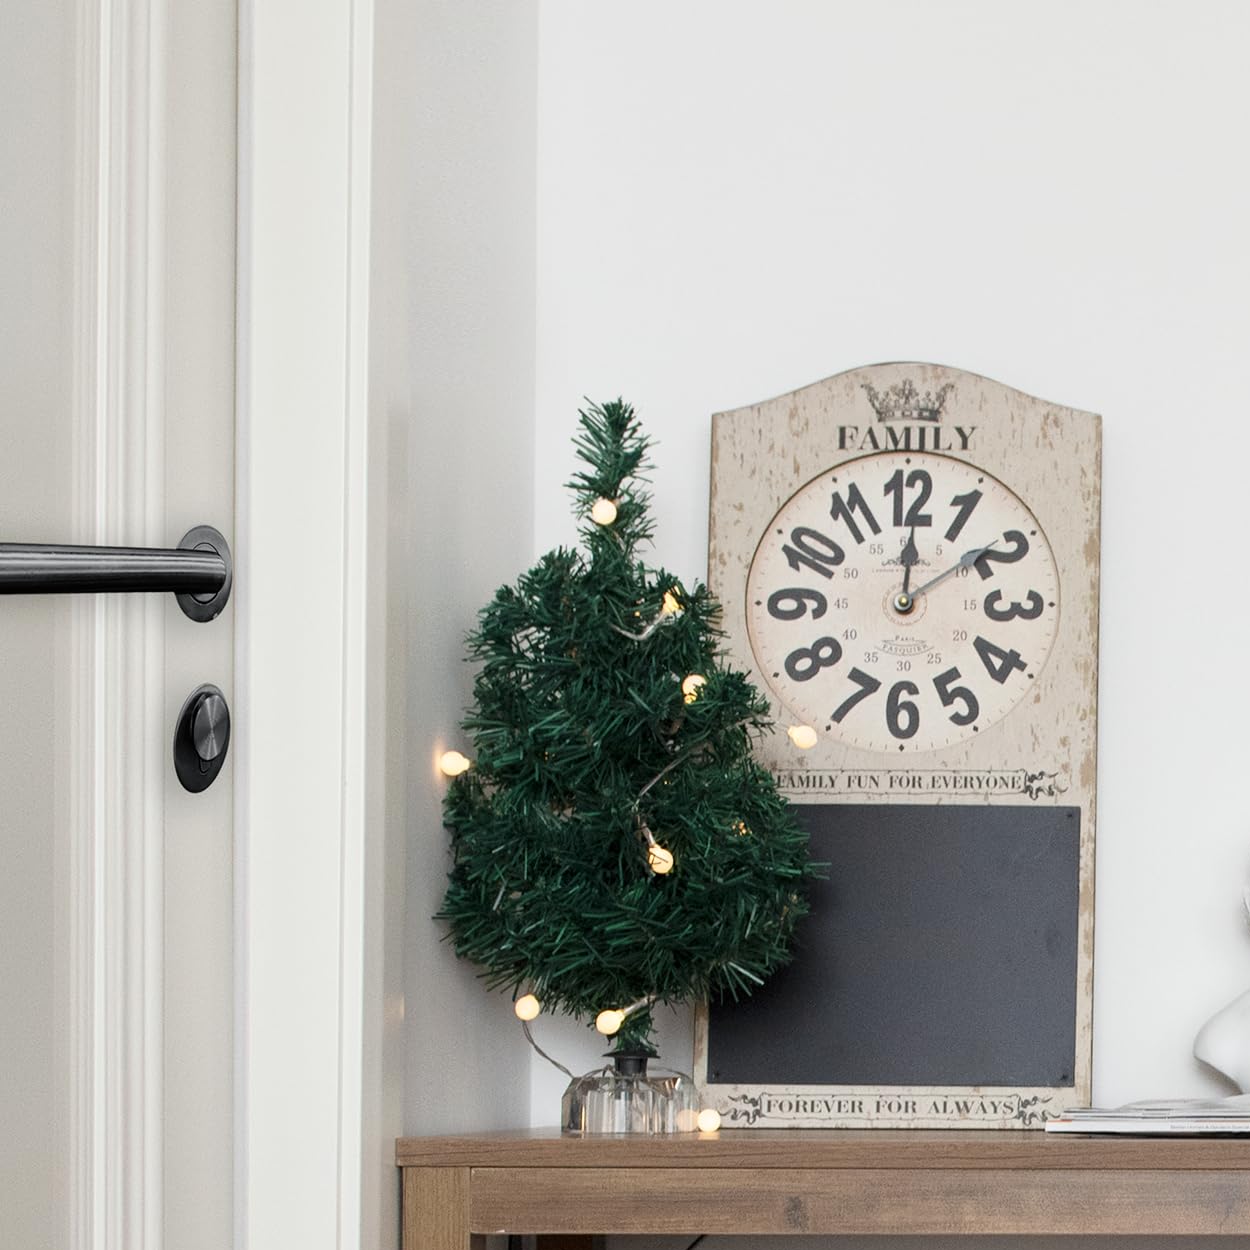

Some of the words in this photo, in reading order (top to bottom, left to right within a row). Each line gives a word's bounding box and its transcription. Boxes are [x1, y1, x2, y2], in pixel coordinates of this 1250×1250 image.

[837, 426, 977, 450] FAMILY
[884, 469, 933, 527] 12
[830, 482, 882, 545] 11
[944, 488, 983, 543] 1
[781, 526, 846, 580] 10
[869, 543, 884, 555] 55
[935, 544, 943, 556] 5
[973, 530, 1030, 581] 2
[843, 568, 858, 579] 50
[954, 567, 969, 578] 10
[767, 587, 828, 621] 9
[833, 598, 849, 610] 45
[963, 600, 977, 611] 15
[983, 589, 1044, 622] 3
[842, 629, 857, 641] 40
[952, 630, 968, 642] 20
[784, 636, 843, 682] 8
[864, 652, 878, 663] 35
[896, 661, 911, 672] 30
[927, 653, 942, 664] 25
[973, 635, 1028, 685] 4
[830, 667, 882, 724] 7
[932, 666, 980, 727] 5
[885, 681, 920, 740] 6
[776, 775, 839, 789] FAMILY
[847, 775, 880, 789] FUN
[889, 775, 923, 789] FOR
[931, 775, 1022, 790] EVERYONE
[765, 1099, 864, 1115] FOREVER
[875, 1100, 918, 1114] FOR
[928, 1098, 1015, 1115] ALWAYS
